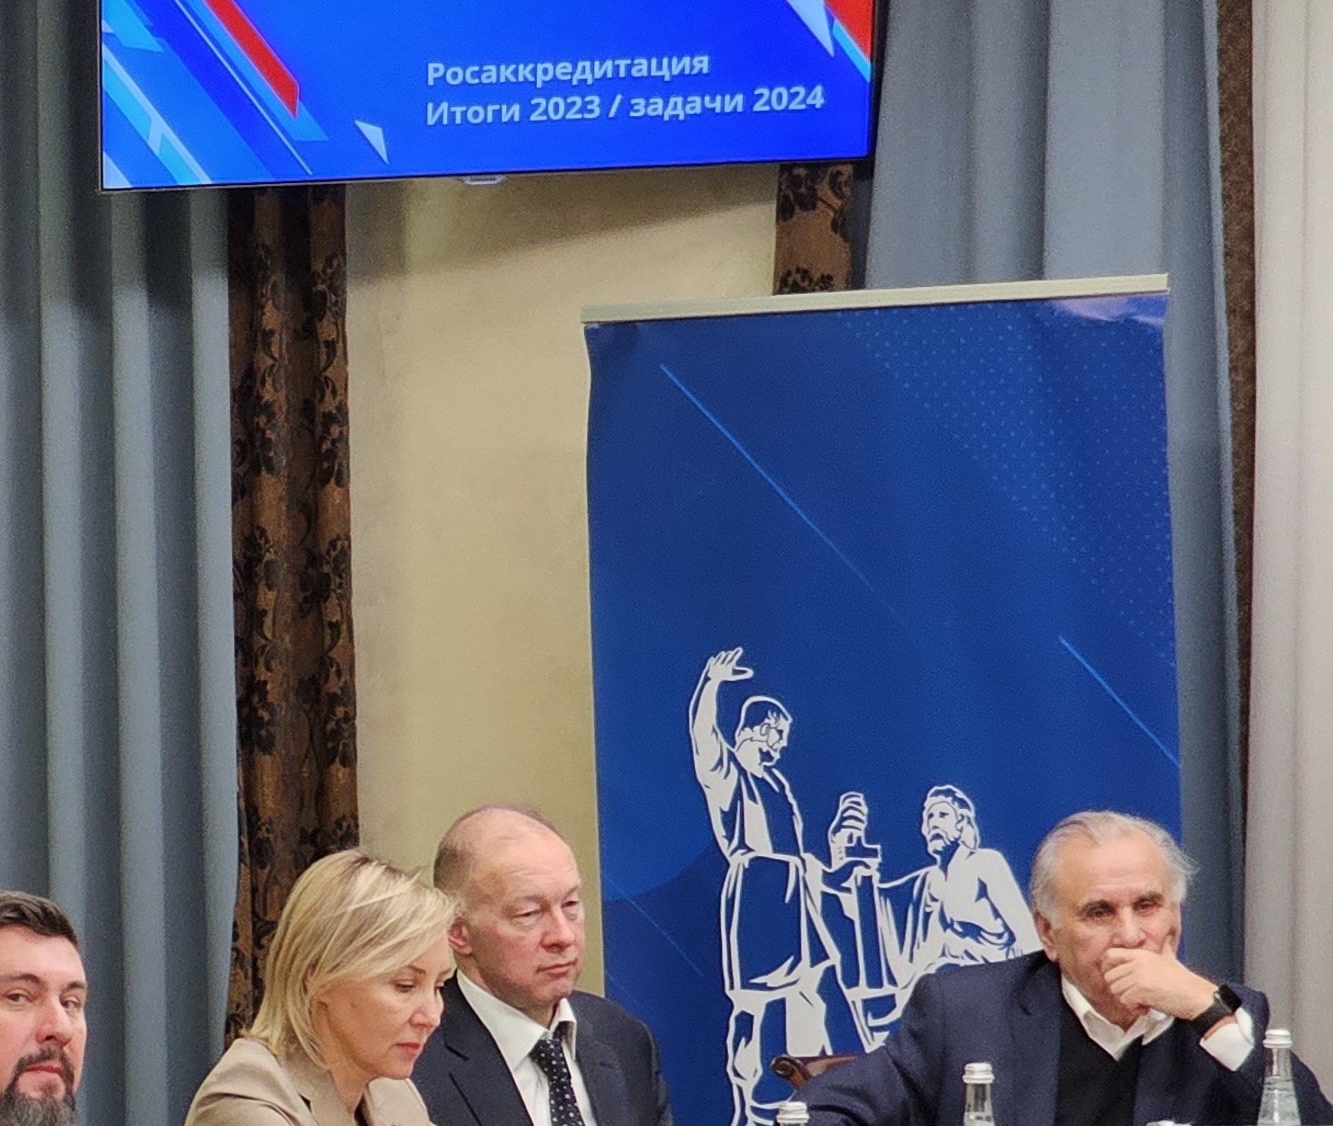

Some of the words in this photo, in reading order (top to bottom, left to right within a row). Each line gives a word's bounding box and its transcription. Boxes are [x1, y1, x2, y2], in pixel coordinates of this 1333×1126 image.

[427, 55, 710, 89] Росаккредитация
[426, 101, 520, 126] Итоги
[529, 95, 601, 121] 2023
[608, 94, 623, 118] /
[629, 93, 744, 121] задачи
[752, 84, 825, 112] 2024
